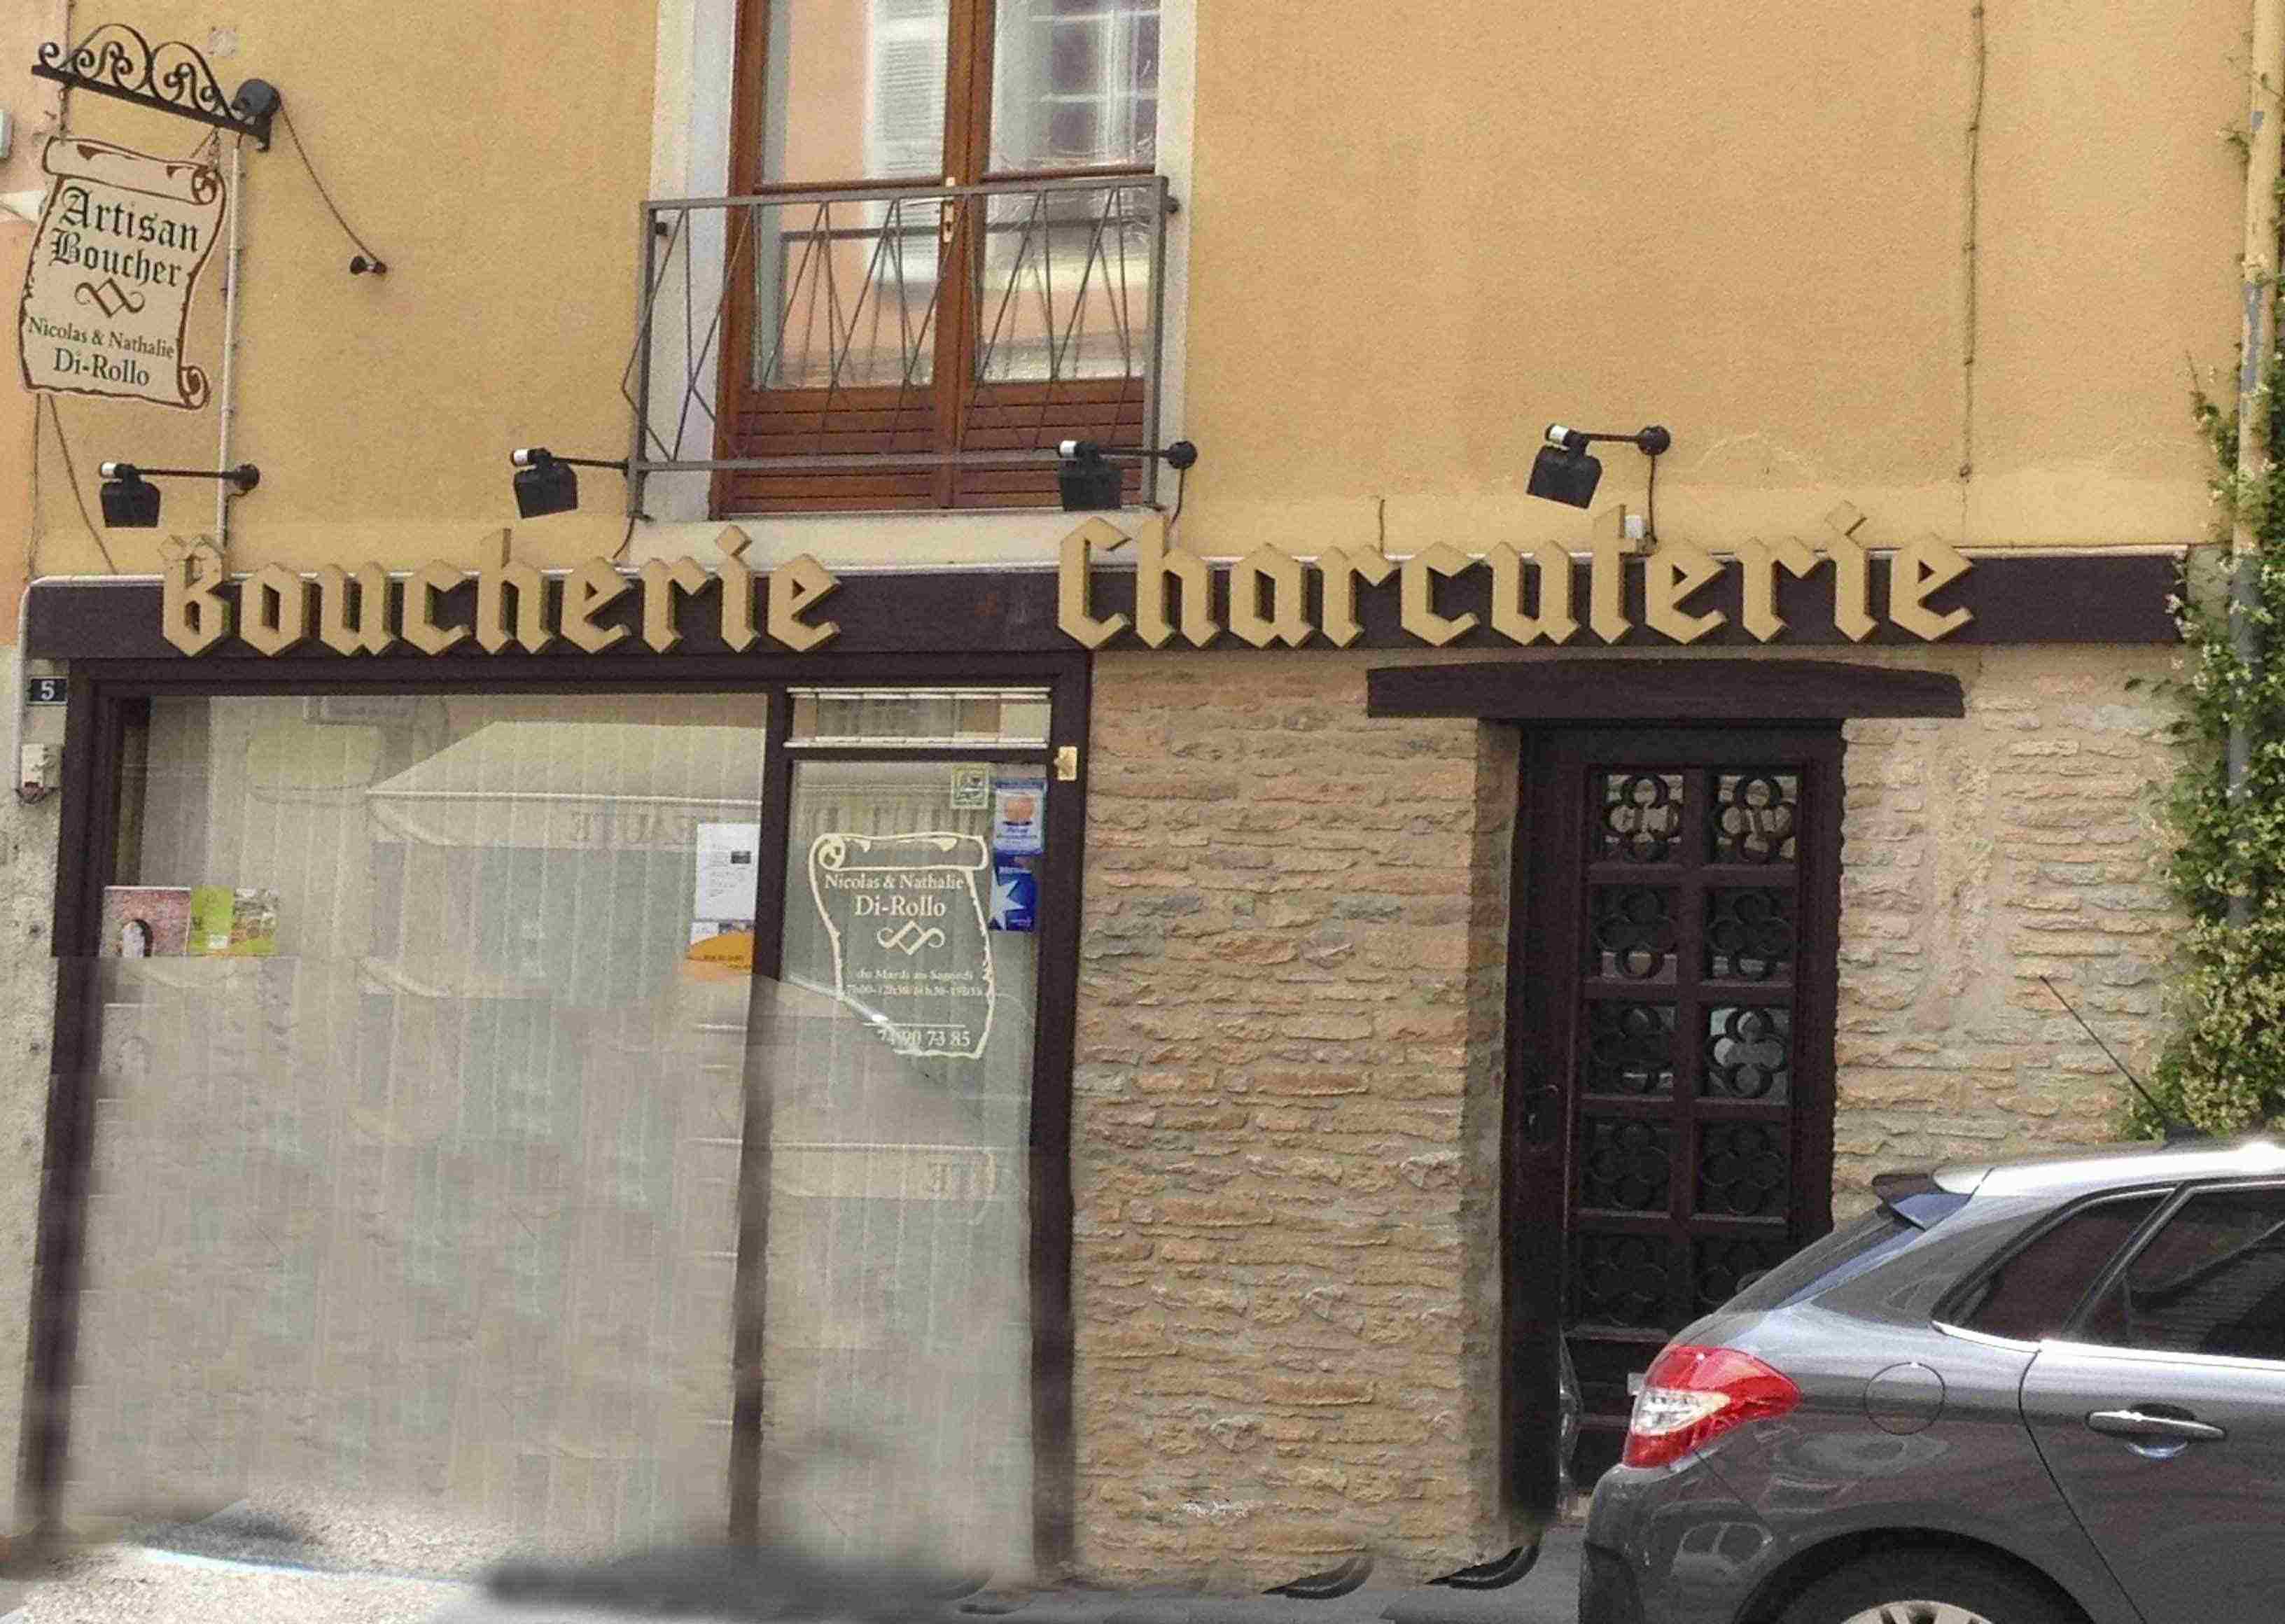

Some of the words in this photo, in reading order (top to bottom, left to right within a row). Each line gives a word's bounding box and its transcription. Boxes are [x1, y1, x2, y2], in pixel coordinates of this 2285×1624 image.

[59, 186, 199, 252] Artisan
[48, 227, 181, 286] Boucher
[29, 316, 87, 343] Nicolas
[92, 329, 103, 346] &
[109, 331, 175, 358] Nathalie
[53, 347, 150, 386] Di-Rollo
[158, 524, 841, 657] Boucherie
[1058, 500, 1977, 650] Charcuterie
[41, 680, 55, 700] 5
[825, 874, 880, 890] Nicolas
[883, 874, 895, 889] &
[899, 874, 964, 890] Nathalie
[853, 895, 946, 917] Di-Rollo
[927, 1030, 946, 1046] 73
[949, 1030, 970, 1046] 85
